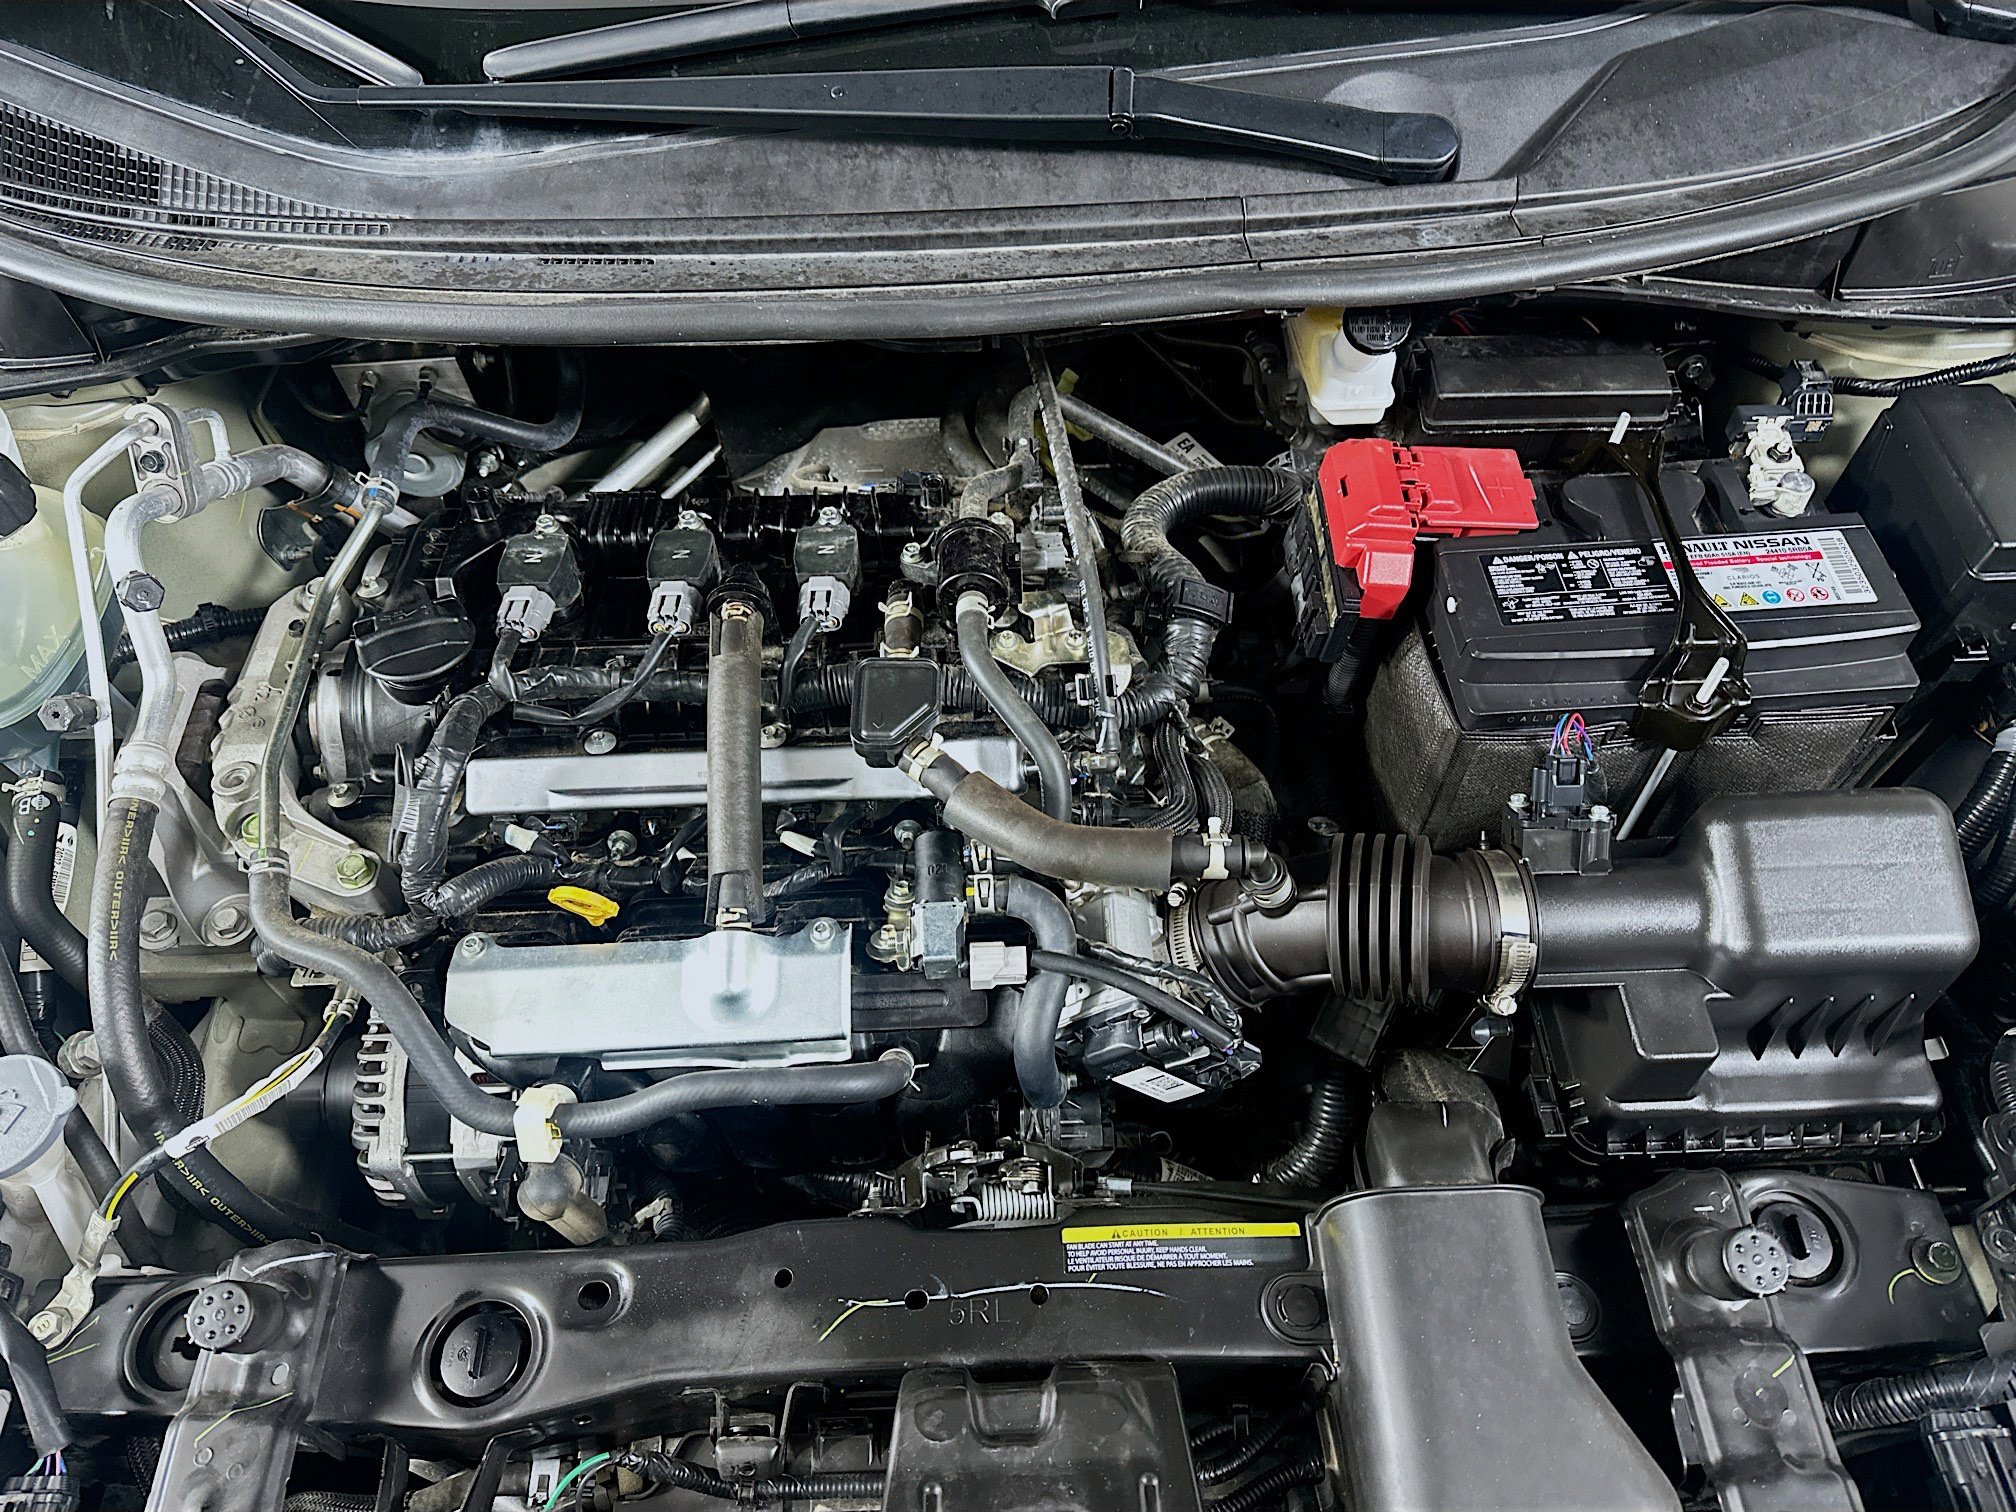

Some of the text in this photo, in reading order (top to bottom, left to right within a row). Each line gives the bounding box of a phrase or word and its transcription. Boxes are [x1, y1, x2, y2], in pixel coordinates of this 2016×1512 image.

[1177, 438, 1195, 454] EA
[1660, 536, 1811, 555] NAULT NISSAN
[1502, 552, 1565, 564] DANGER/POISON
[1578, 547, 1642, 559] PELIGRO/VENENO
[1727, 573, 1761, 581] CLARIOS
[21, 624, 68, 680] MAX
[18, 796, 32, 815] B
[1122, 1228, 1168, 1238] CAUTION
[1190, 1227, 1246, 1236] ATTENTION
[1067, 1250, 1076, 1258] TO
[1076, 1249, 1089, 1257] HELP
[1090, 1248, 1107, 1257] AVOID
[1108, 1247, 1136, 1256] PERSONAL
[1156, 1246, 1169, 1254] KEEP
[1169, 1245, 1188, 1253] HANDS
[1189, 1245, 1208, 1253] CLEAR.
[1078, 1242, 1096, 1250] BLADE
[1097, 1241, 1109, 1249] CAN
[1109, 1240, 1125, 1248] START
[1125, 1240, 1133, 1248] AT
[1075, 1256, 1114, 1264] VENTILATEUR
[1115, 1255, 1136, 1263] RISQUE
[1183, 1252, 1199, 1260] TOUT
[1200, 1252, 1229, 1260] MOMENT.
[1086, 1262, 1106, 1271] ÉVITER
[1106, 1262, 1126, 1270] TOUTE
[1166, 1260, 1178, 1268] PAS
[1178, 1260, 1187, 1268] EN
[1187, 1259, 1222, 1267] APPROCHER
[1222, 1259, 1233, 1267] LES
[1233, 1258, 1255, 1266] MAINS.
[949, 1297, 1011, 1325] 5RL
